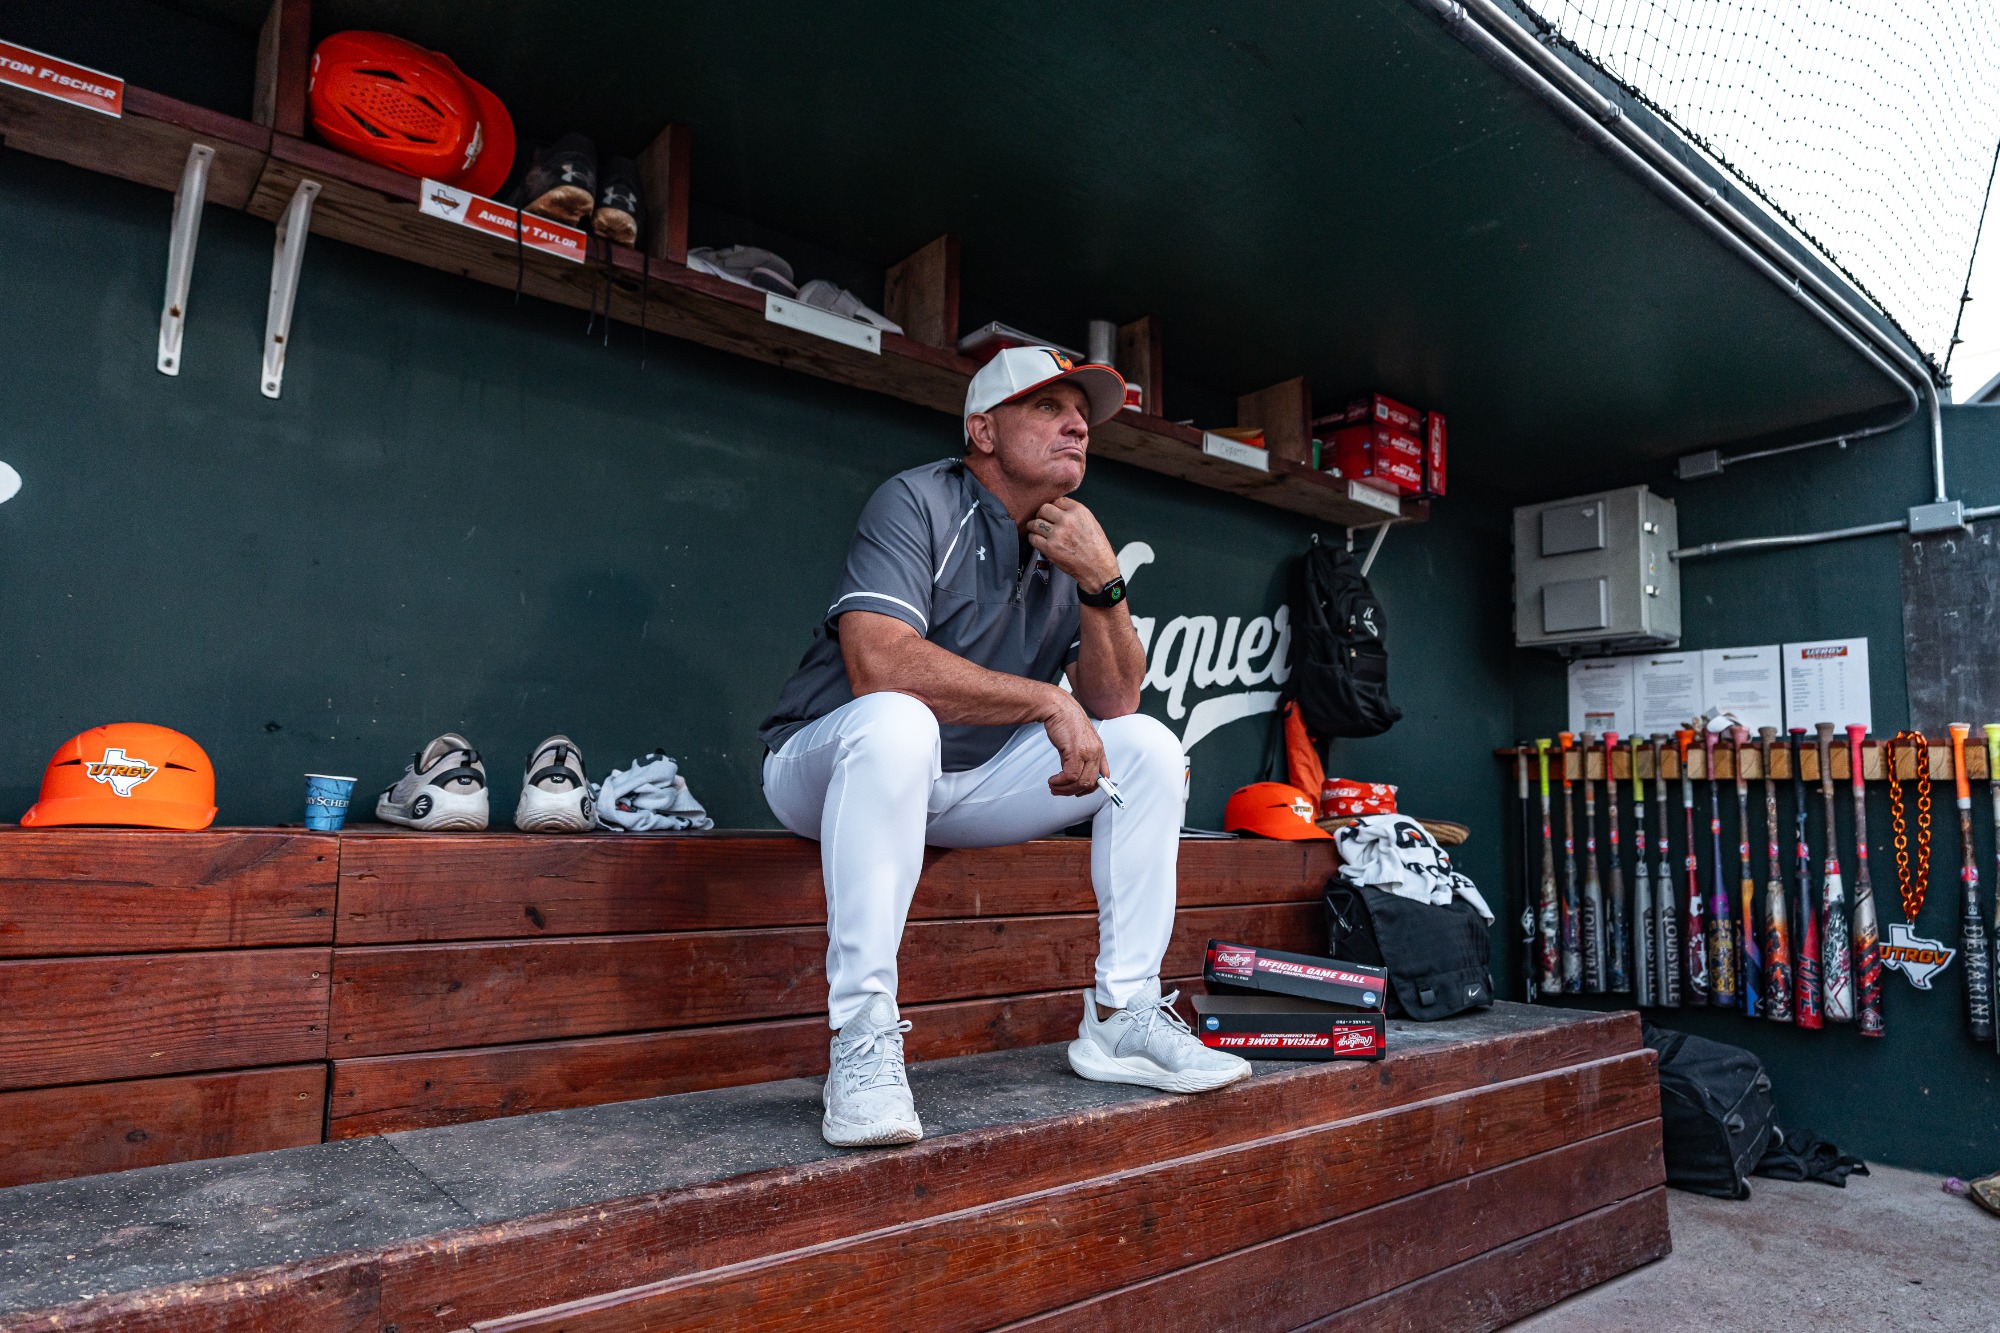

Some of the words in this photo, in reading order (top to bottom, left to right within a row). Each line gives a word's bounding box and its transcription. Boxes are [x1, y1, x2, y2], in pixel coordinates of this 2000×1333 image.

[38, 68, 117, 100] FISCHER
[532, 227, 578, 249] TAYLOR
[90, 763, 155, 779] UTRGV
[1217, 952, 1252, 968] Rawlings
[1664, 916, 1681, 1002] LOUISVILLE
[1879, 945, 1951, 966] UTRGV
[1258, 960, 1303, 974] OFFICIAL
[1306, 967, 1337, 979] GAME
[1339, 973, 1365, 984] BALL
[1964, 924, 1990, 1025] DEMARINI
[1798, 953, 1821, 1017] HYPE
[1219, 1037, 1246, 1045] BALL
[1248, 1037, 1279, 1046] GAME
[1282, 1038, 1330, 1046] OFFICIAL
[1336, 1033, 1373, 1048] Rawlings
